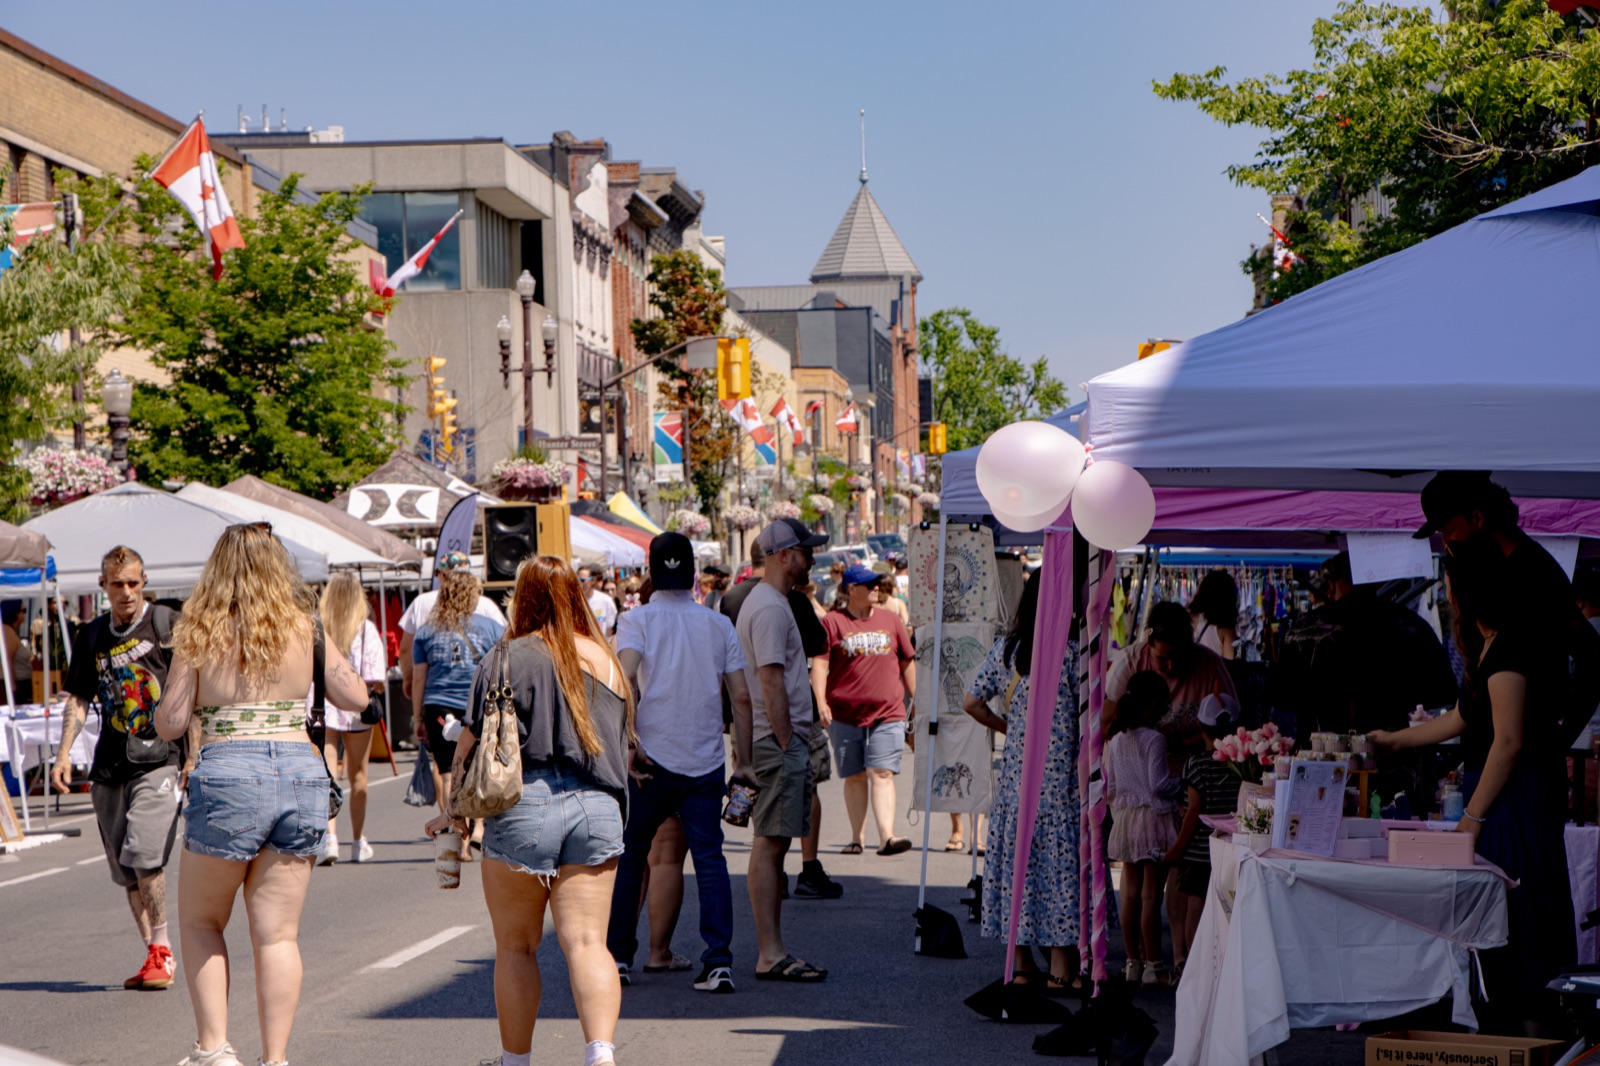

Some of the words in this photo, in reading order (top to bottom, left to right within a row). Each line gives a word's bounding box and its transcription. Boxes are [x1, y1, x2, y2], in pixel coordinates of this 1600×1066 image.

[538, 440, 569, 449] Hunter
[570, 439, 596, 449] Street
[110, 638, 139, 656] MAZING
[1376, 1047, 1393, 1061] is.)
[1395, 1049, 1404, 1062] it
[1405, 1050, 1433, 1064] here
[1434, 1050, 1499, 1066] (Seriously,
